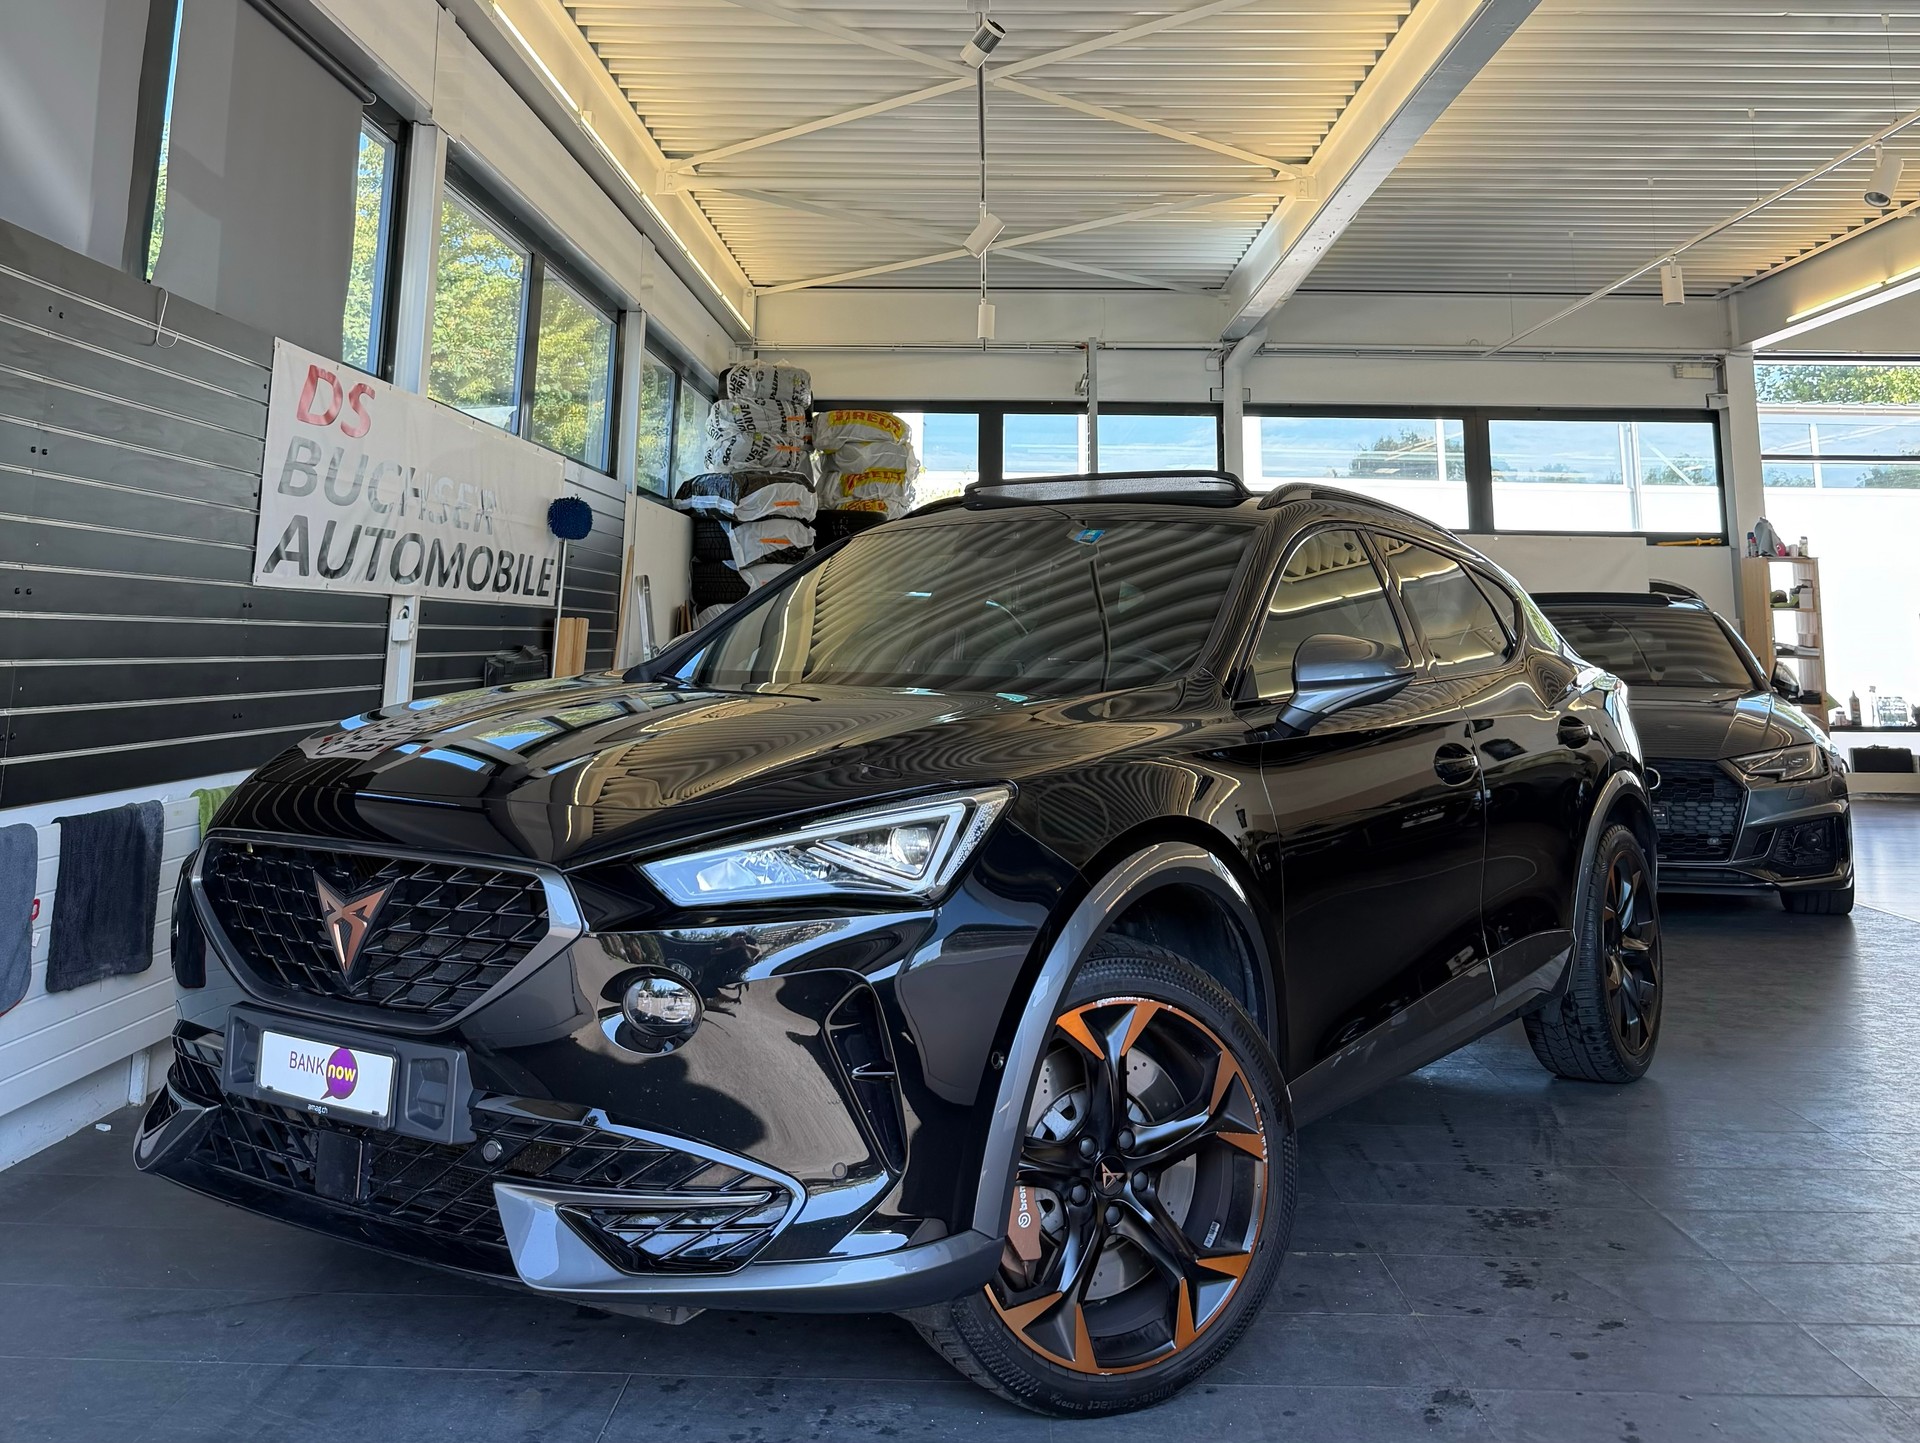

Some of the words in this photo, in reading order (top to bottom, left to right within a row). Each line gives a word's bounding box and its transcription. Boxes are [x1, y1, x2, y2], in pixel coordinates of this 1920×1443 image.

[297, 364, 376, 438] DS
[263, 514, 554, 598] AUTOMOBILE
[289, 1050, 326, 1076] BANK
[327, 1064, 357, 1082] now
[1019, 1185, 1028, 1211] brem
[1086, 1383, 1176, 1411] WinterContact
